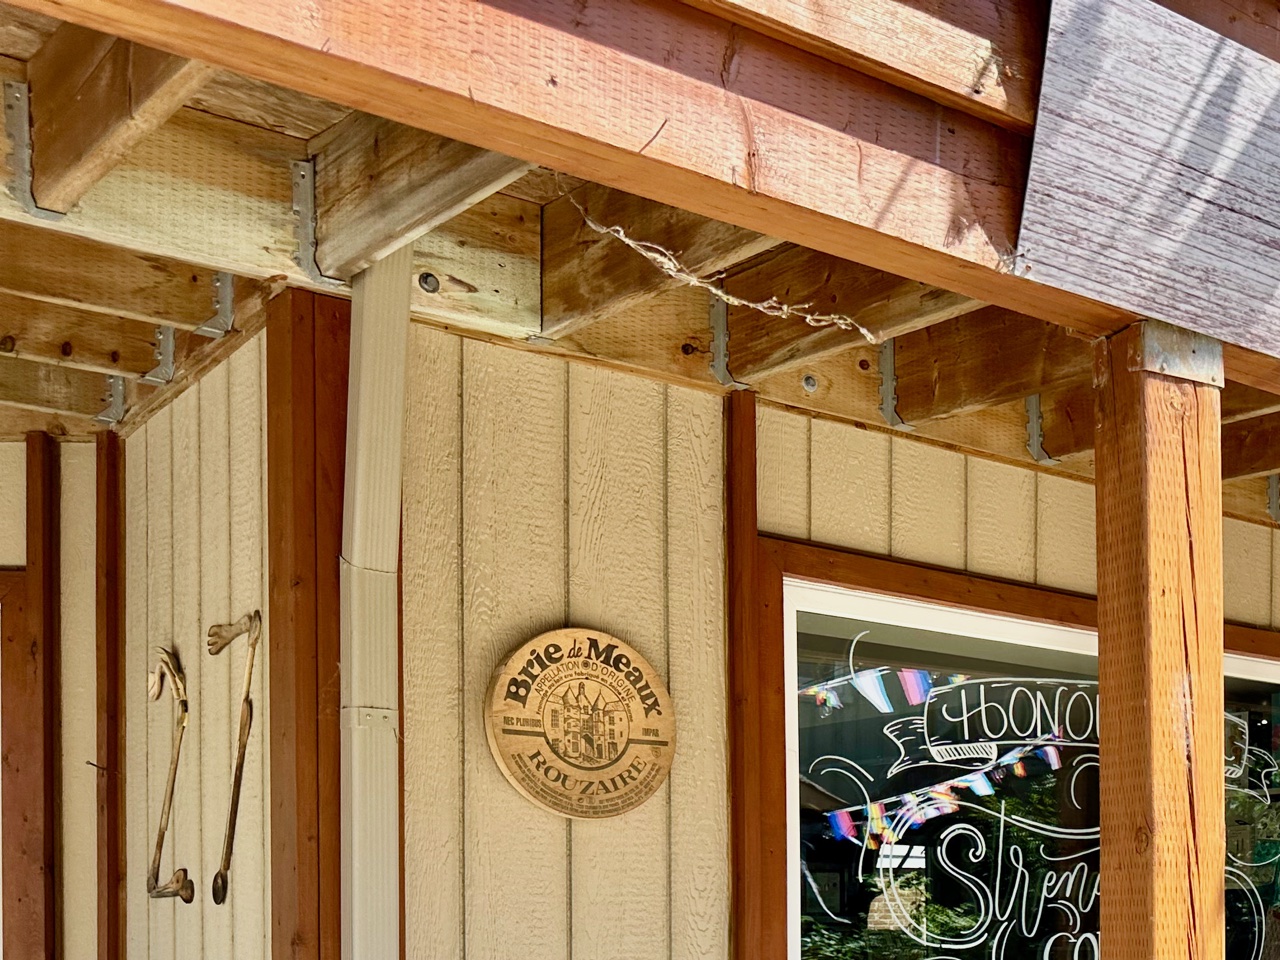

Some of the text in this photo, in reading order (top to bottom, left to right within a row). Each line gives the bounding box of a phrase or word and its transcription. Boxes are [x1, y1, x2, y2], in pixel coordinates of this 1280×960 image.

[503, 637, 662, 718] Brie de Meaux
[534, 661, 637, 704] APPELLATION D'ORIGINE
[528, 749, 648, 796] ROUZAIRE
